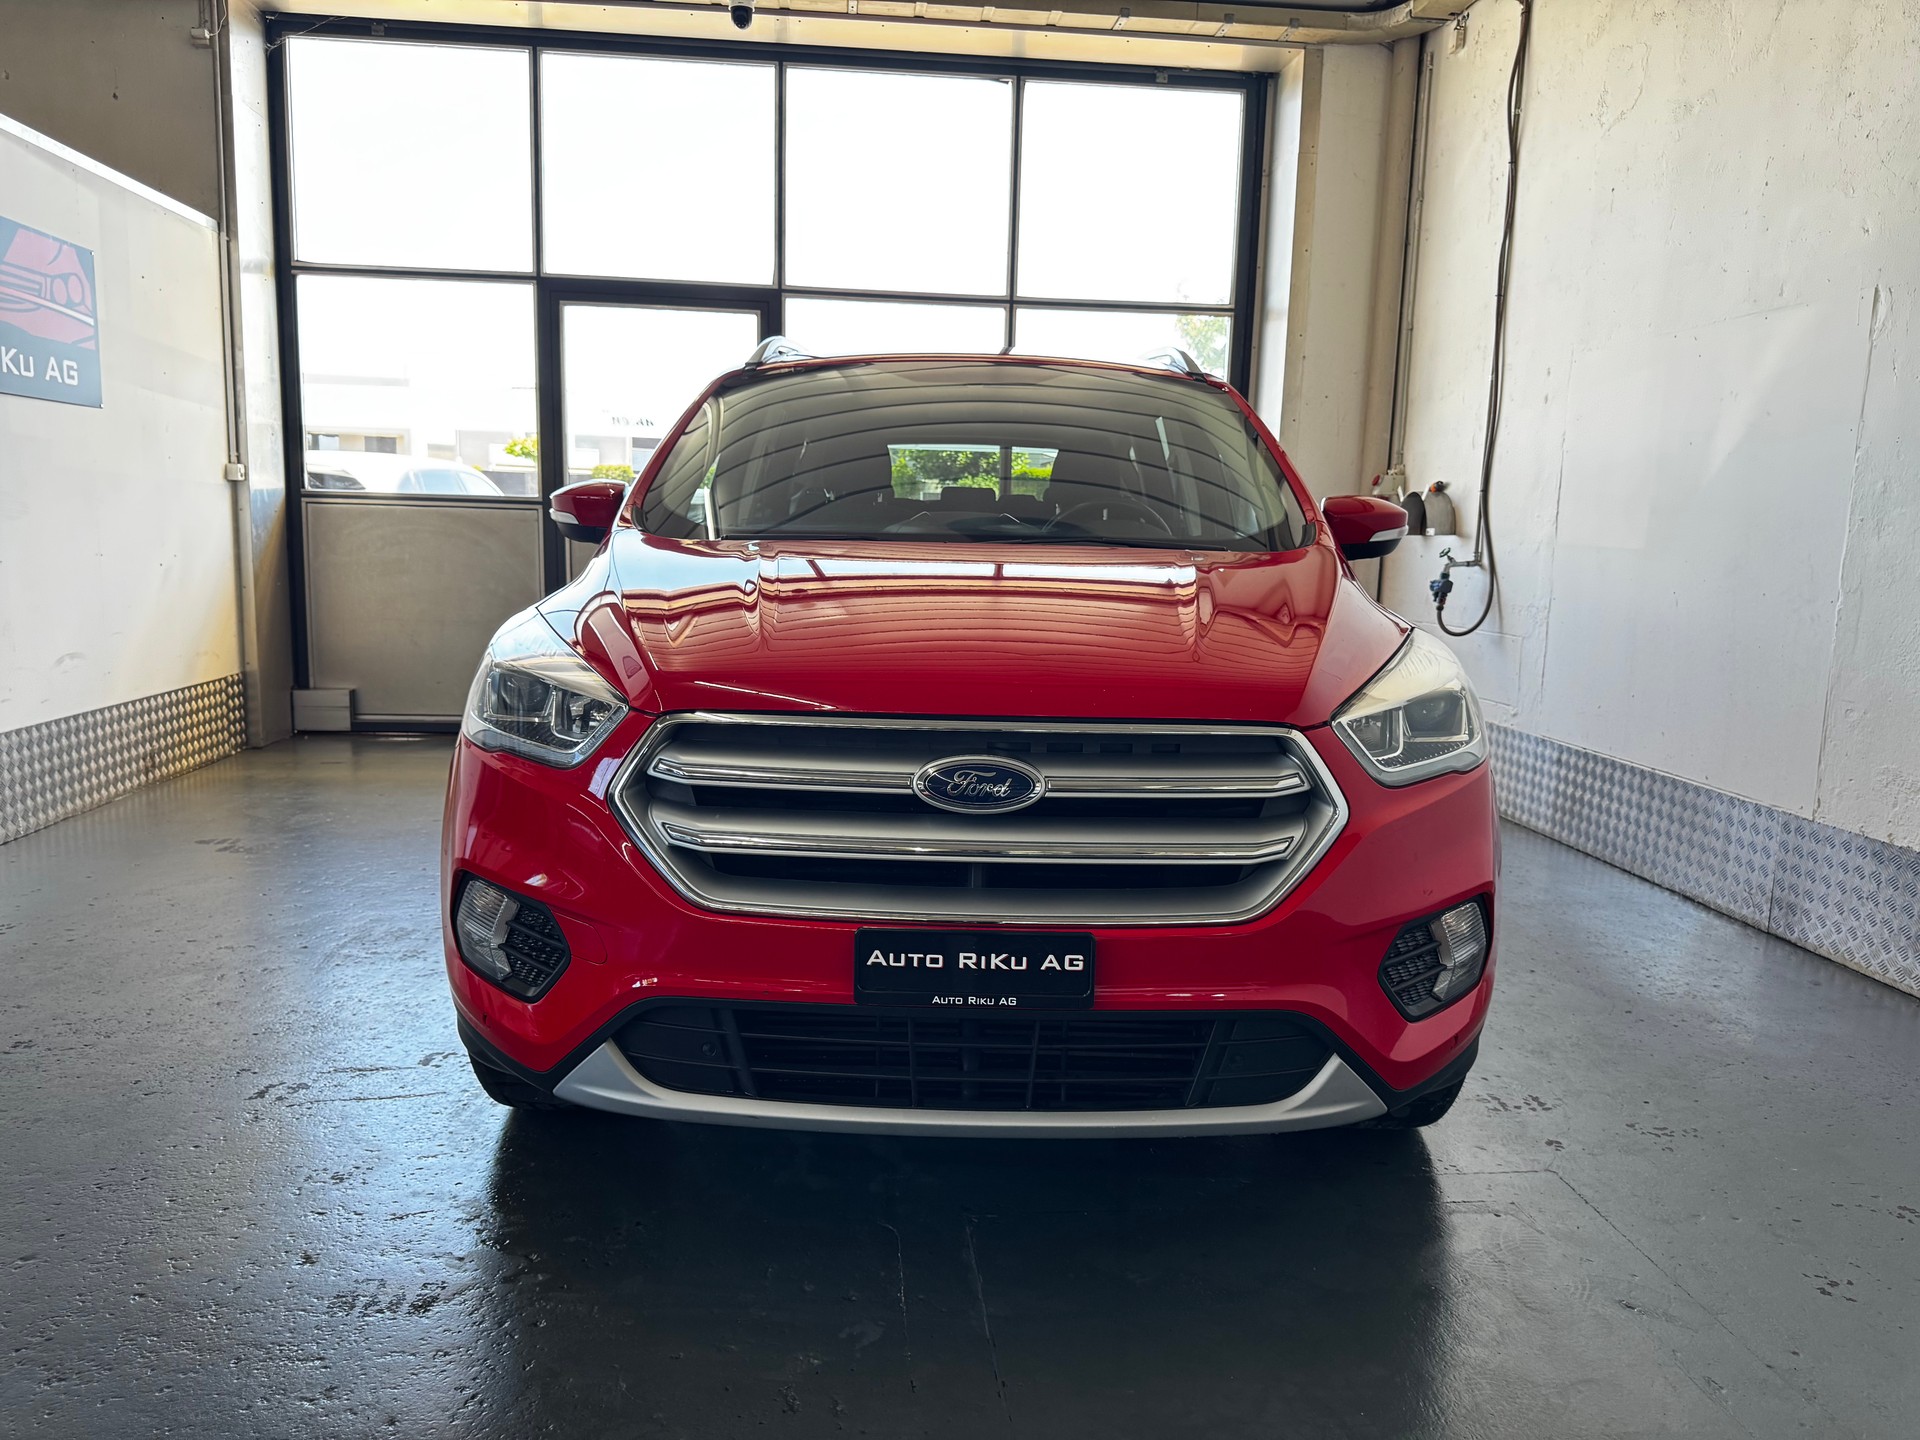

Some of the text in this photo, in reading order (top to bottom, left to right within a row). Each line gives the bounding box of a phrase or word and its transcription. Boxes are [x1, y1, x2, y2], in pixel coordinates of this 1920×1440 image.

[45, 356, 79, 386] AG
[946, 769, 1012, 797] Ford
[1040, 954, 1085, 971] AG
[999, 997, 1017, 1006] AG
